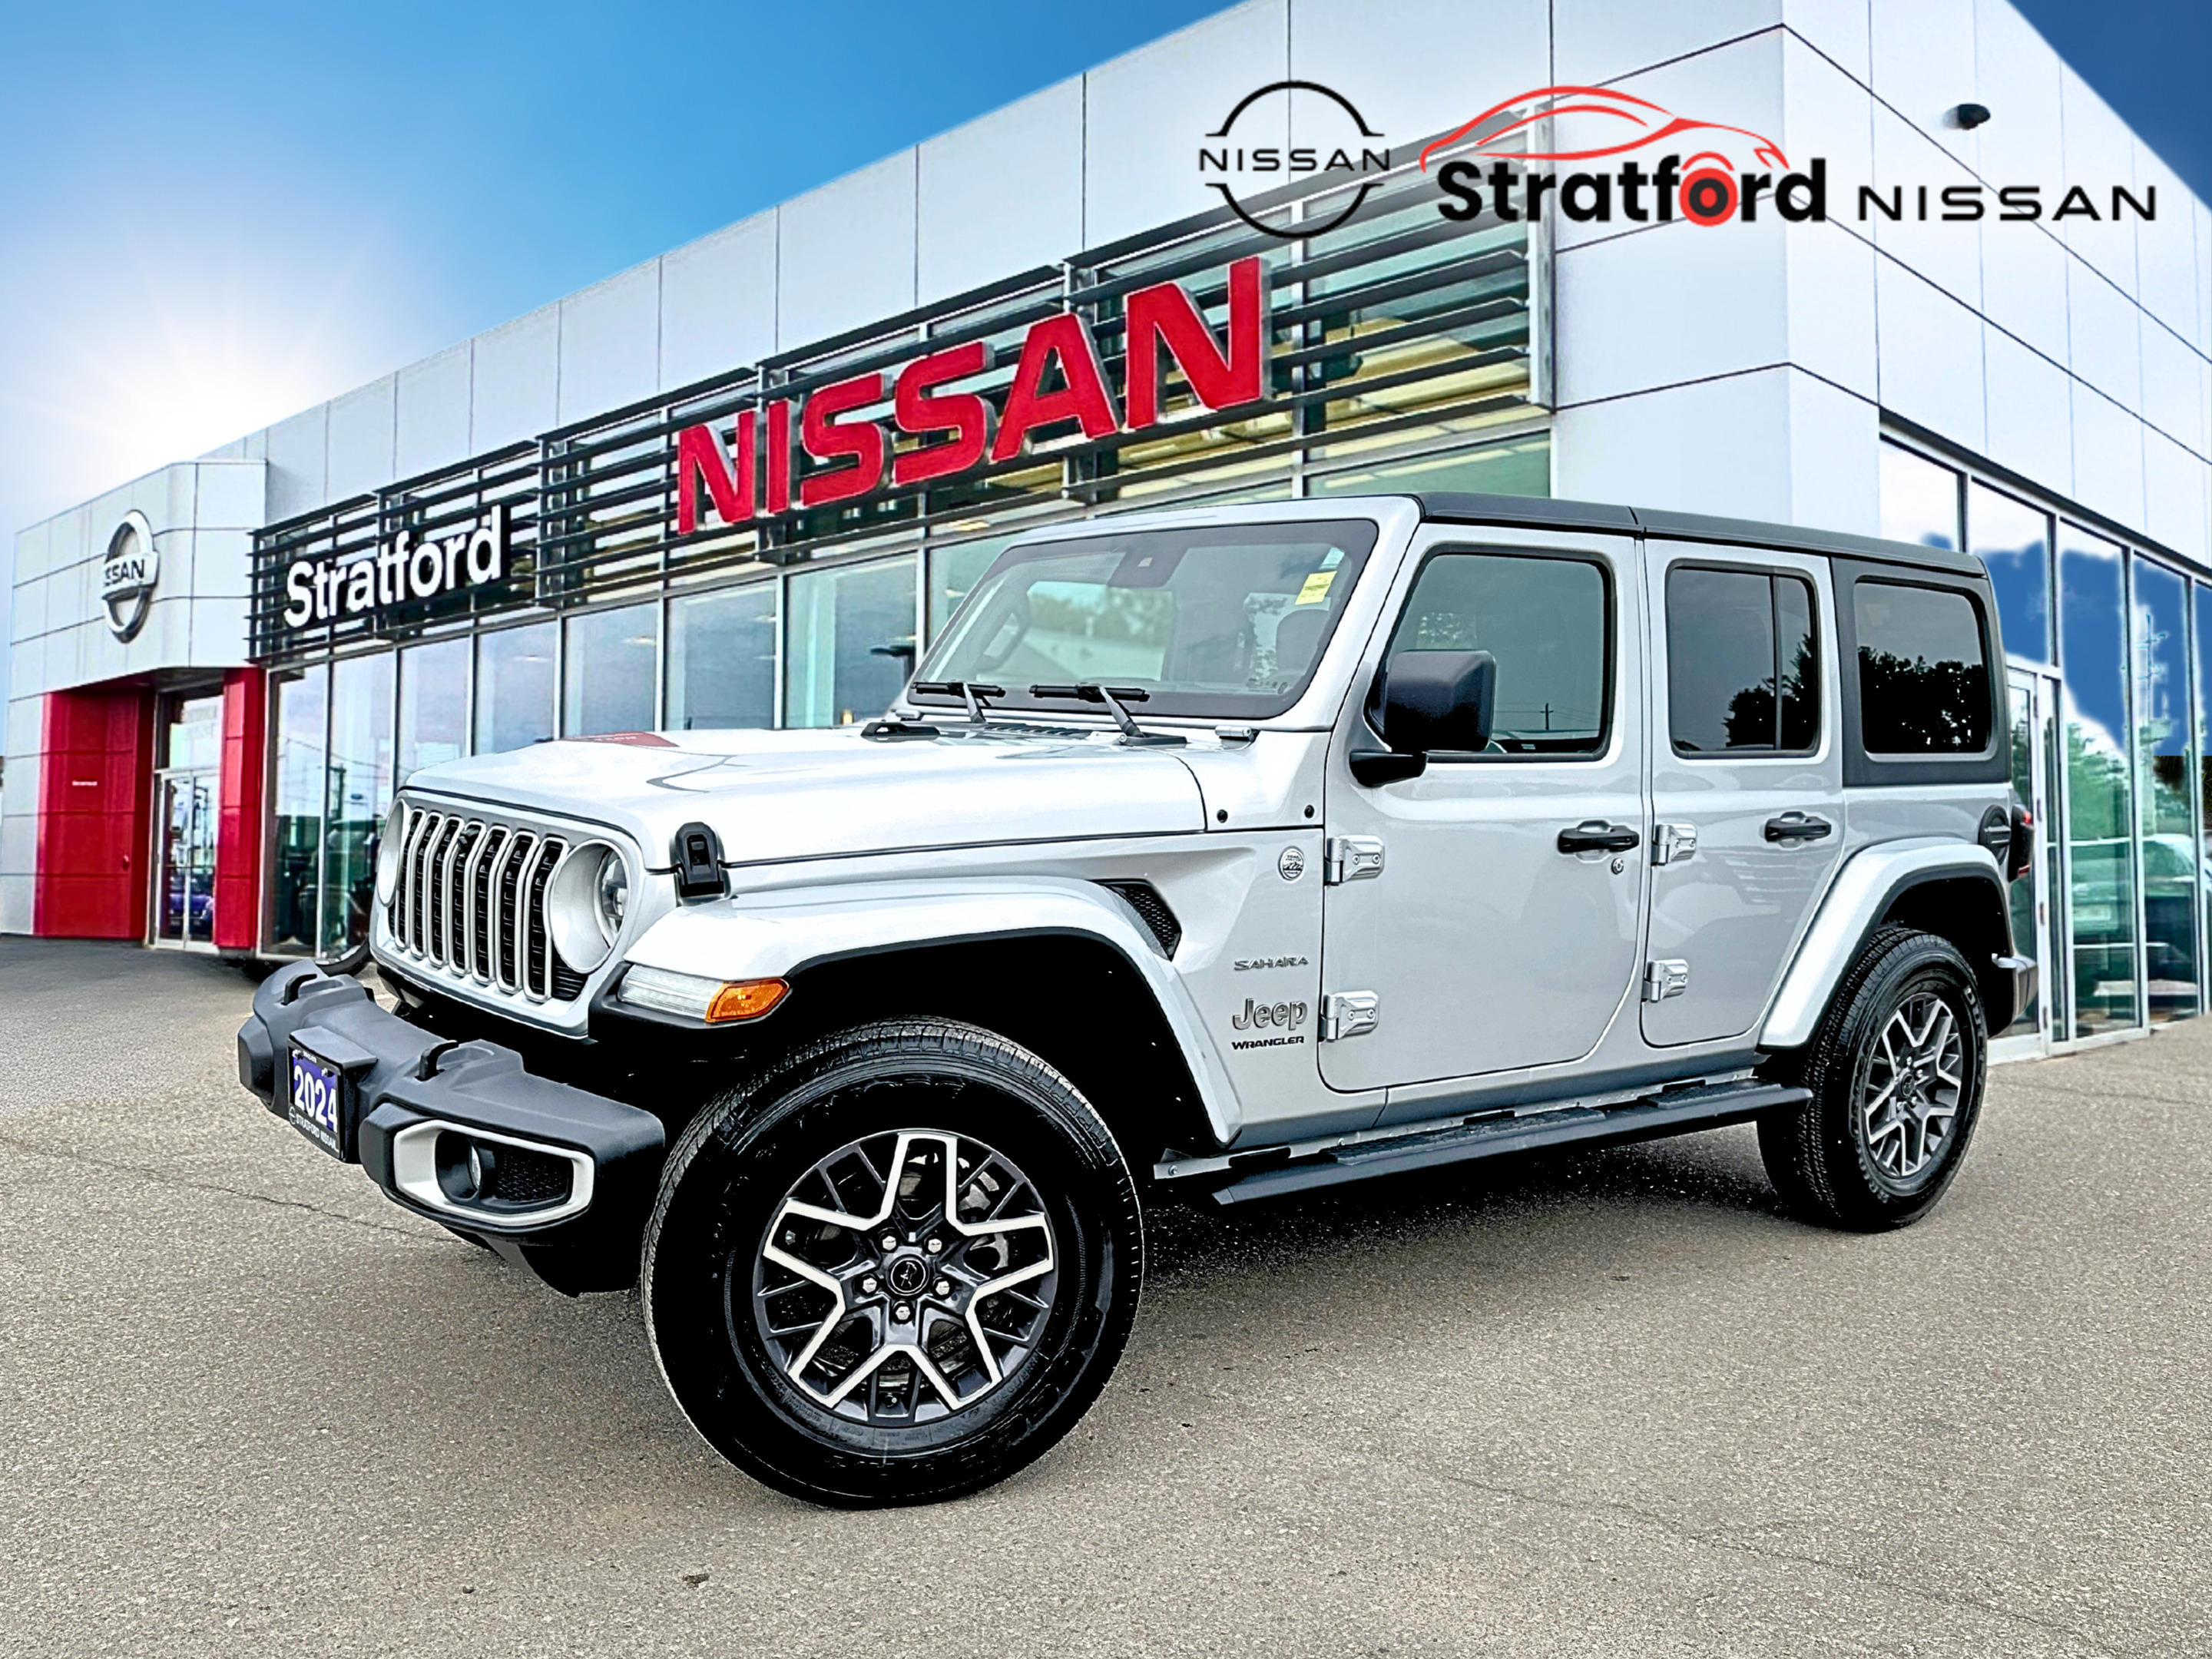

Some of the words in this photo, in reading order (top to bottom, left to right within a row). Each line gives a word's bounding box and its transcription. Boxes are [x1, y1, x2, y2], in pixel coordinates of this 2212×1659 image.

[677, 256, 1270, 535] NISSAN
[283, 504, 502, 628] Stratford
[1233, 956, 1309, 972] SAHARA
[1232, 998, 1308, 1031] Jeep
[1231, 1035, 1305, 1051] WRANGLER
[293, 1065, 338, 1134] 2024
[296, 1113, 320, 1139] STRATFORD
[320, 1129, 338, 1151] NISSAN
